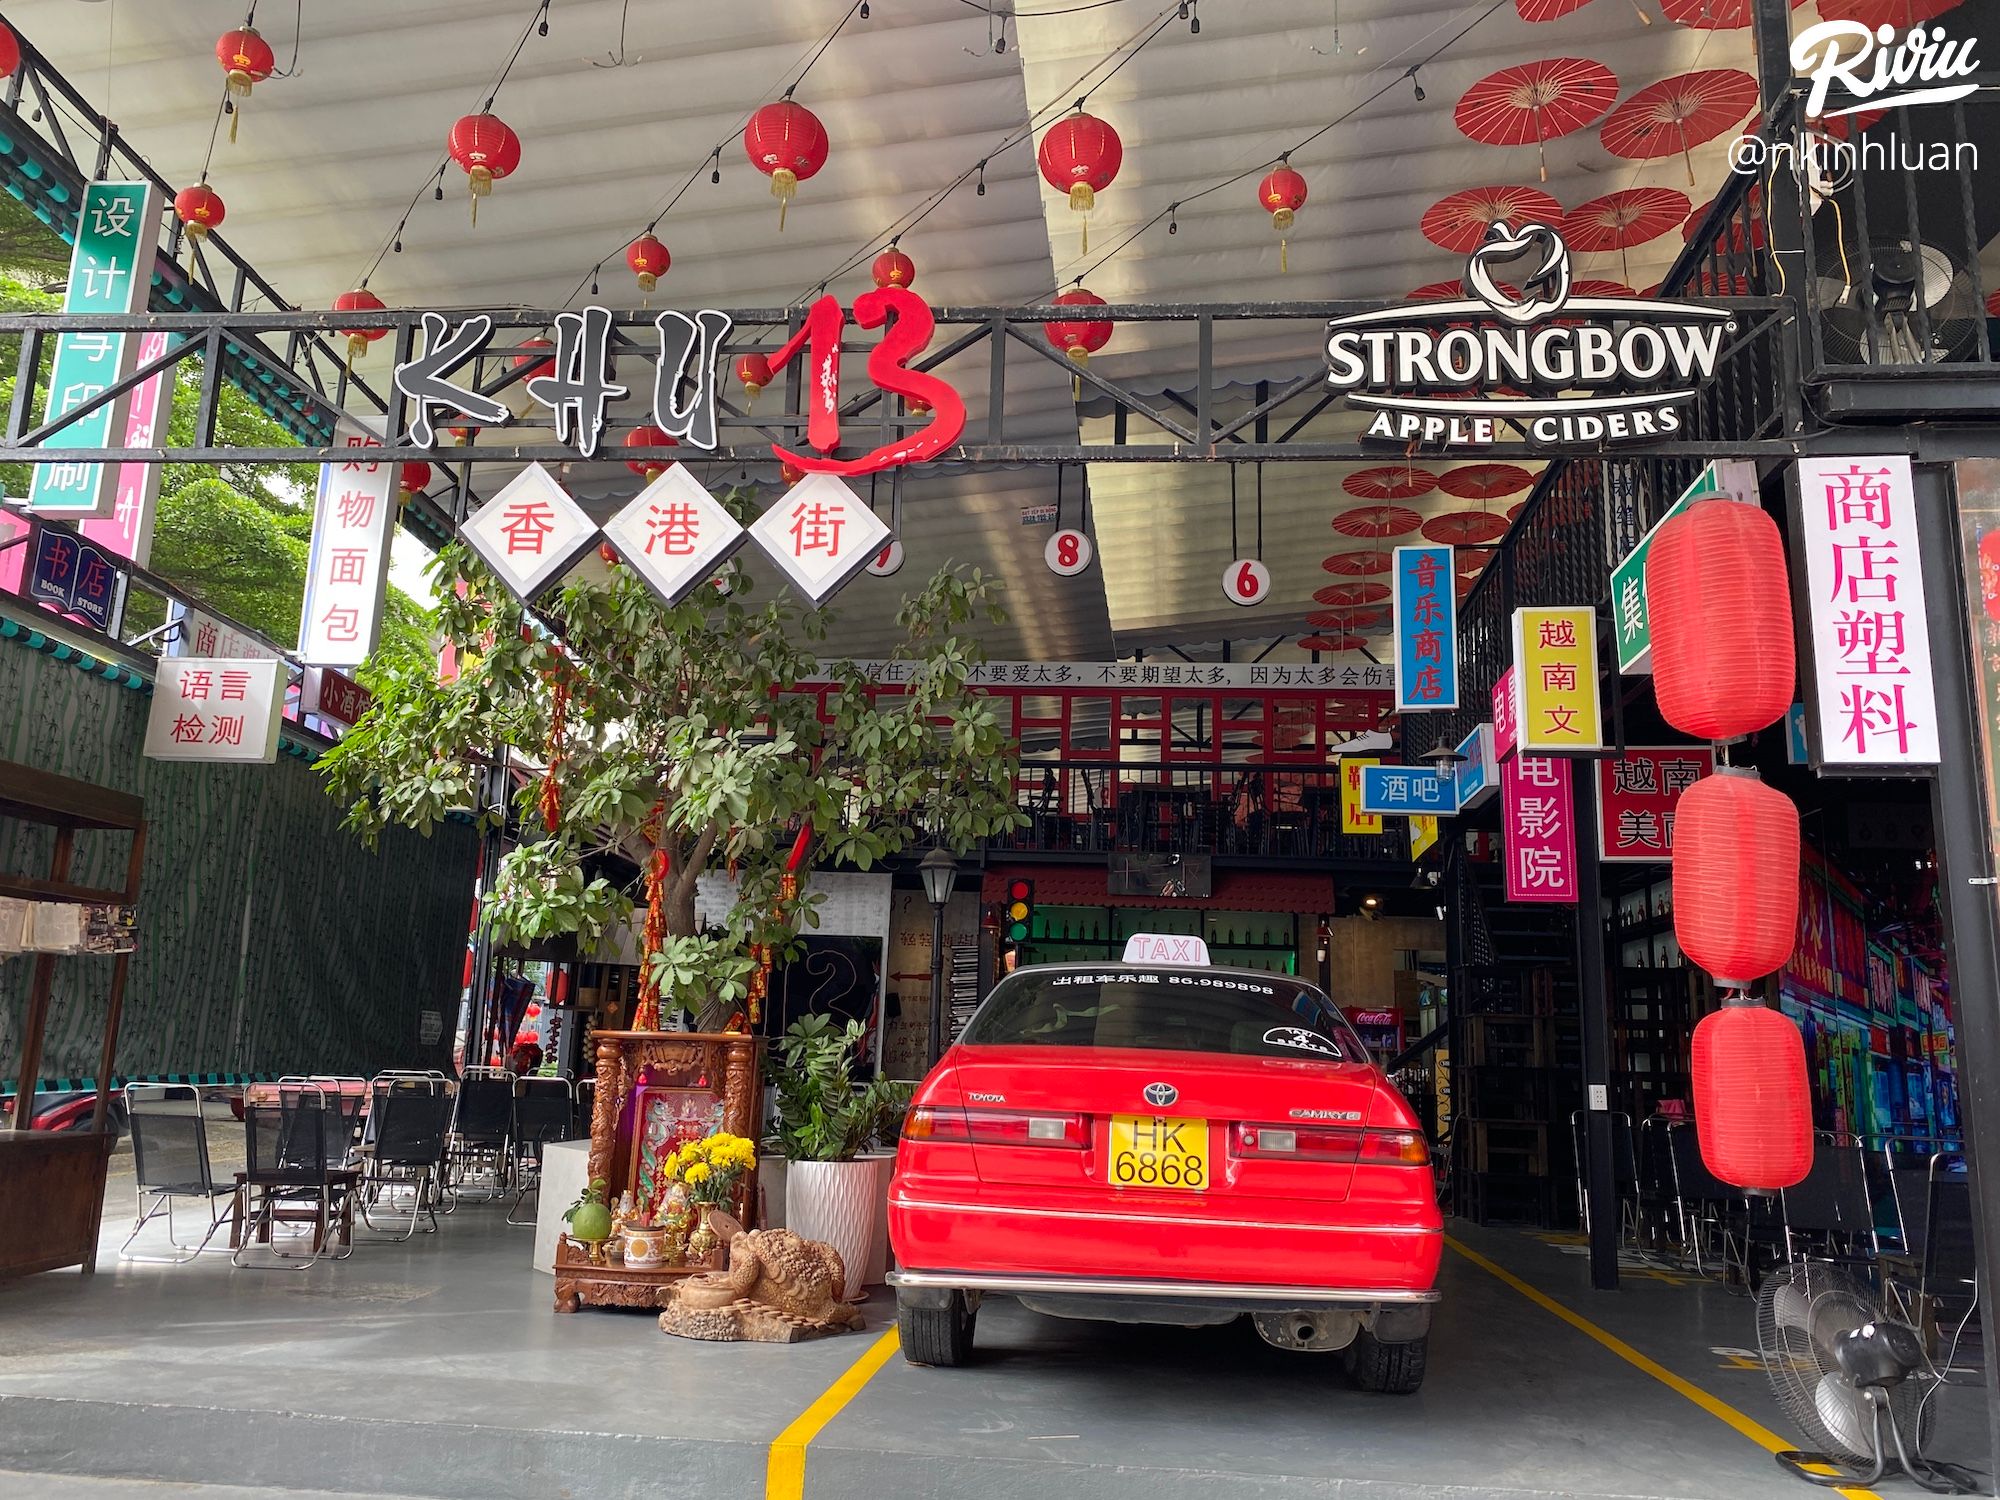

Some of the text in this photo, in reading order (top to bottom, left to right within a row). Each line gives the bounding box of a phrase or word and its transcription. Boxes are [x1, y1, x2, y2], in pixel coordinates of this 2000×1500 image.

[1327, 323, 1723, 387] STRONGBOW
[395, 307, 731, 458] KHU
[1367, 406, 1681, 444] APPLE CIDERS
[44, 537, 107, 598] 书店
[1057, 534, 1080, 567] 8
[40, 578, 104, 616] BOOK STORE
[1236, 562, 1259, 598] 6
[1620, 560, 1650, 645] 集
[1818, 464, 1918, 754] 商店塑料
[1407, 552, 1446, 701] 音乐商店
[180, 671, 252, 702] 语言
[1539, 619, 1581, 735] 越南文
[171, 713, 245, 746] 检测
[1380, 775, 1441, 803] 酒吧
[1517, 757, 1565, 890] 电影院
[1133, 937, 1202, 963] TAXI
[1168, 975, 1275, 996] 86.989898
[967, 1092, 1007, 1103] TOYOTA
[1133, 1120, 1187, 1153] HK
[1116, 1151, 1204, 1187] 6868
